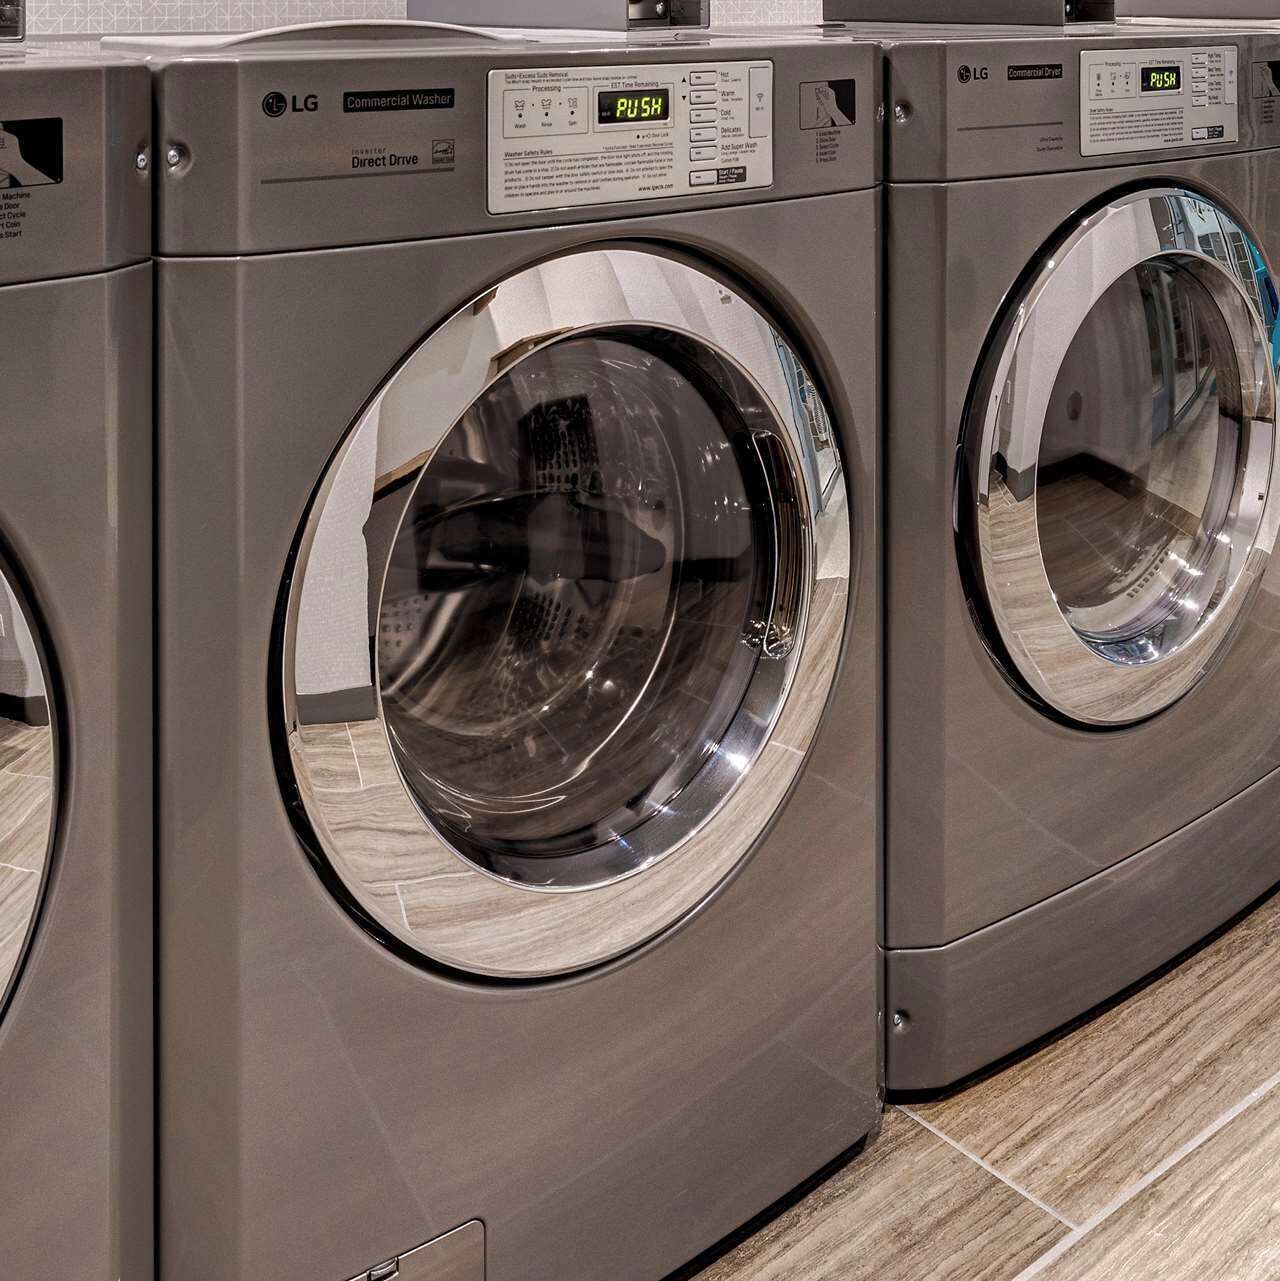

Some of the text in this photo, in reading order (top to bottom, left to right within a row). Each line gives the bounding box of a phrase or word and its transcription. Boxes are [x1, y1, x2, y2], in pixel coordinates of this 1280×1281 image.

[973, 67, 988, 80] LG
[1150, 72, 1177, 87] PUSH
[292, 94, 319, 113] LG
[347, 93, 451, 109] Commercial Washer
[616, 97, 662, 118] PUSH
[352, 155, 386, 169] Direct
[389, 153, 418, 166] Drive
